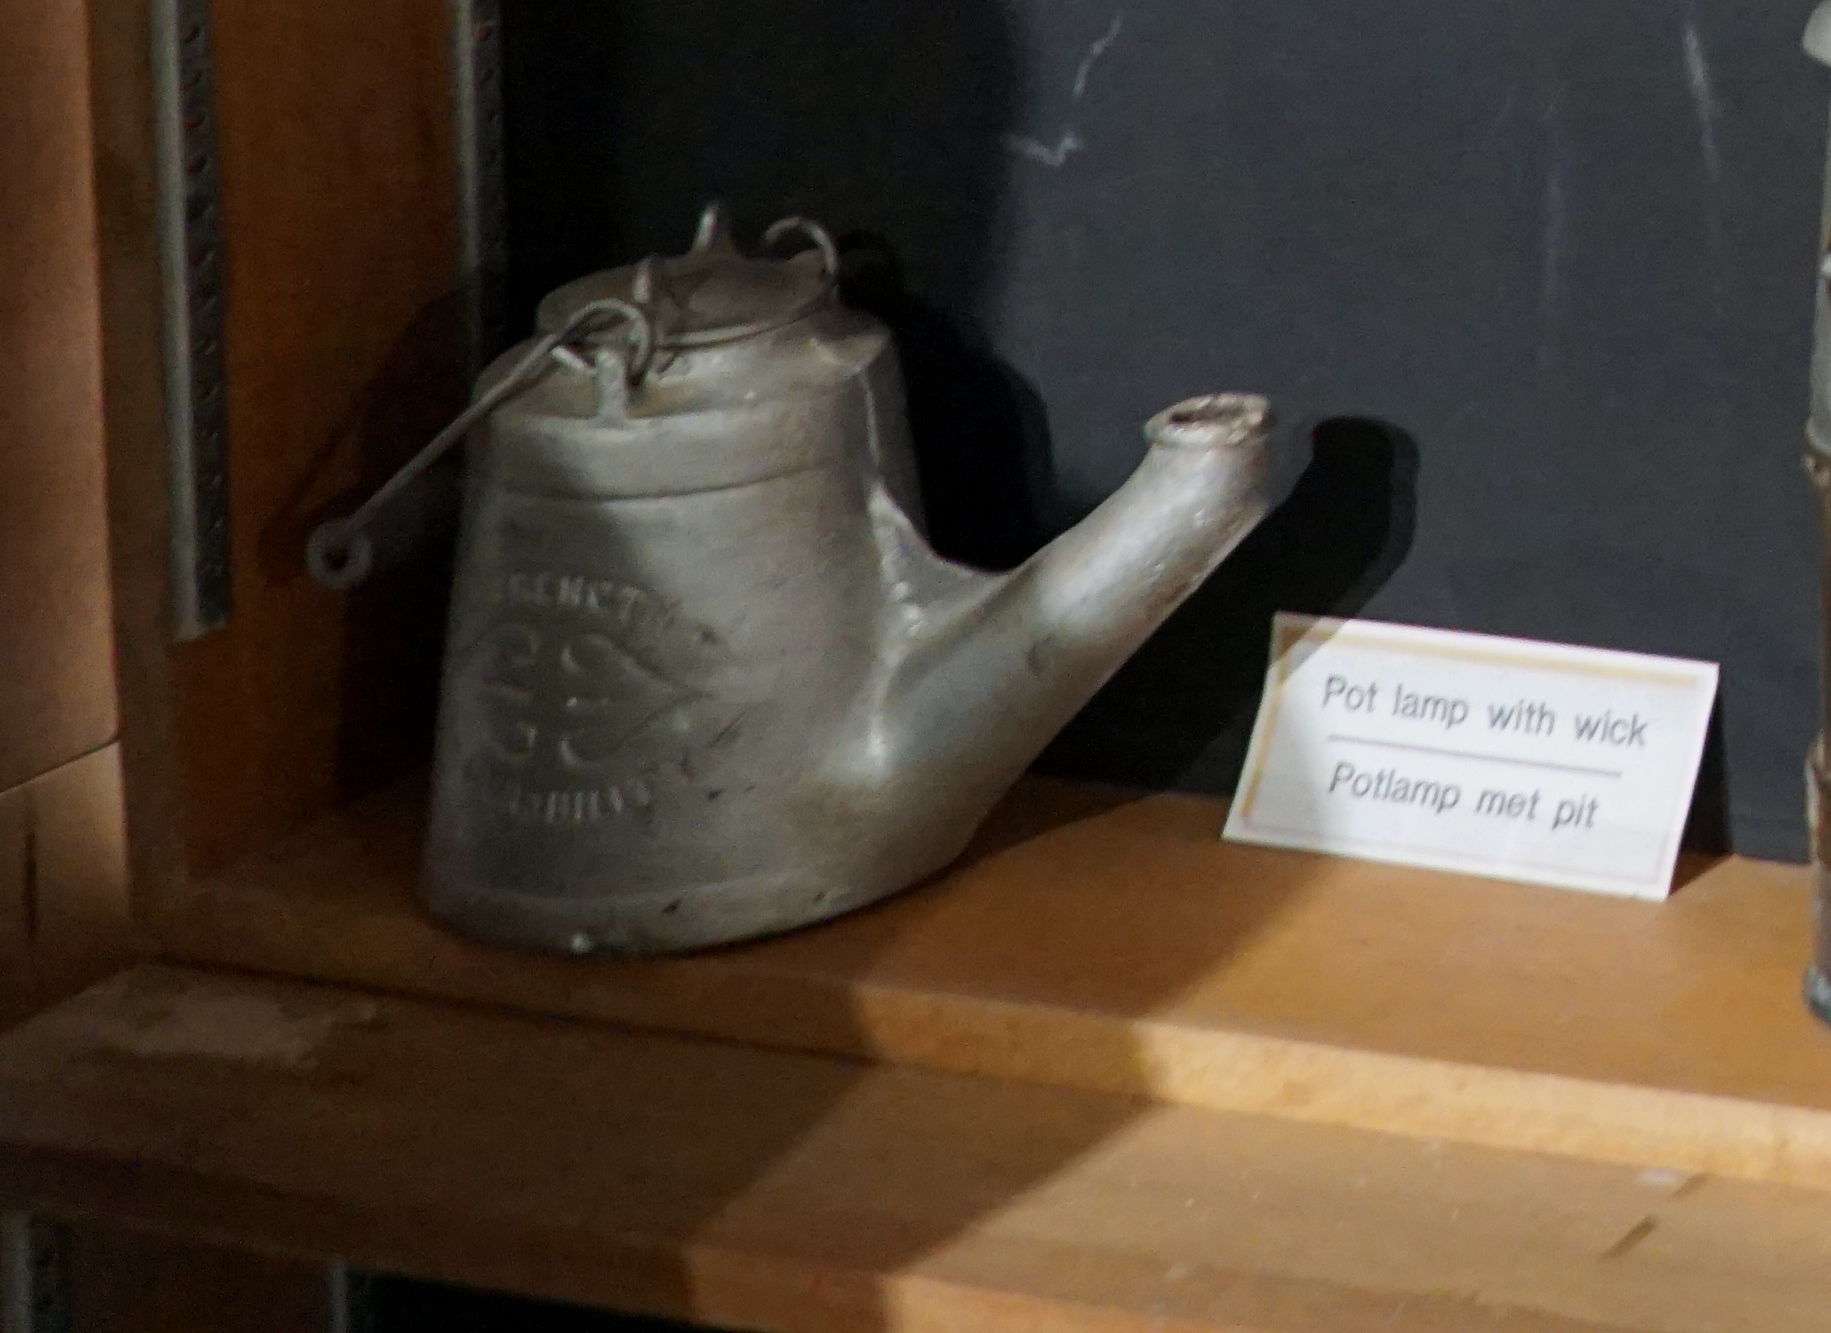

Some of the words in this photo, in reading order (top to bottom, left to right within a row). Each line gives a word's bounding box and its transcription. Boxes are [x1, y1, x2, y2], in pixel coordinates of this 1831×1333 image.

[1322, 673, 1378, 713] Pot
[1392, 683, 1469, 728] lamp
[1487, 697, 1556, 736] with
[1573, 708, 1649, 747] wick
[1328, 760, 1462, 812] Potlamp
[1475, 786, 1542, 821] met
[1552, 797, 1601, 831] pit
